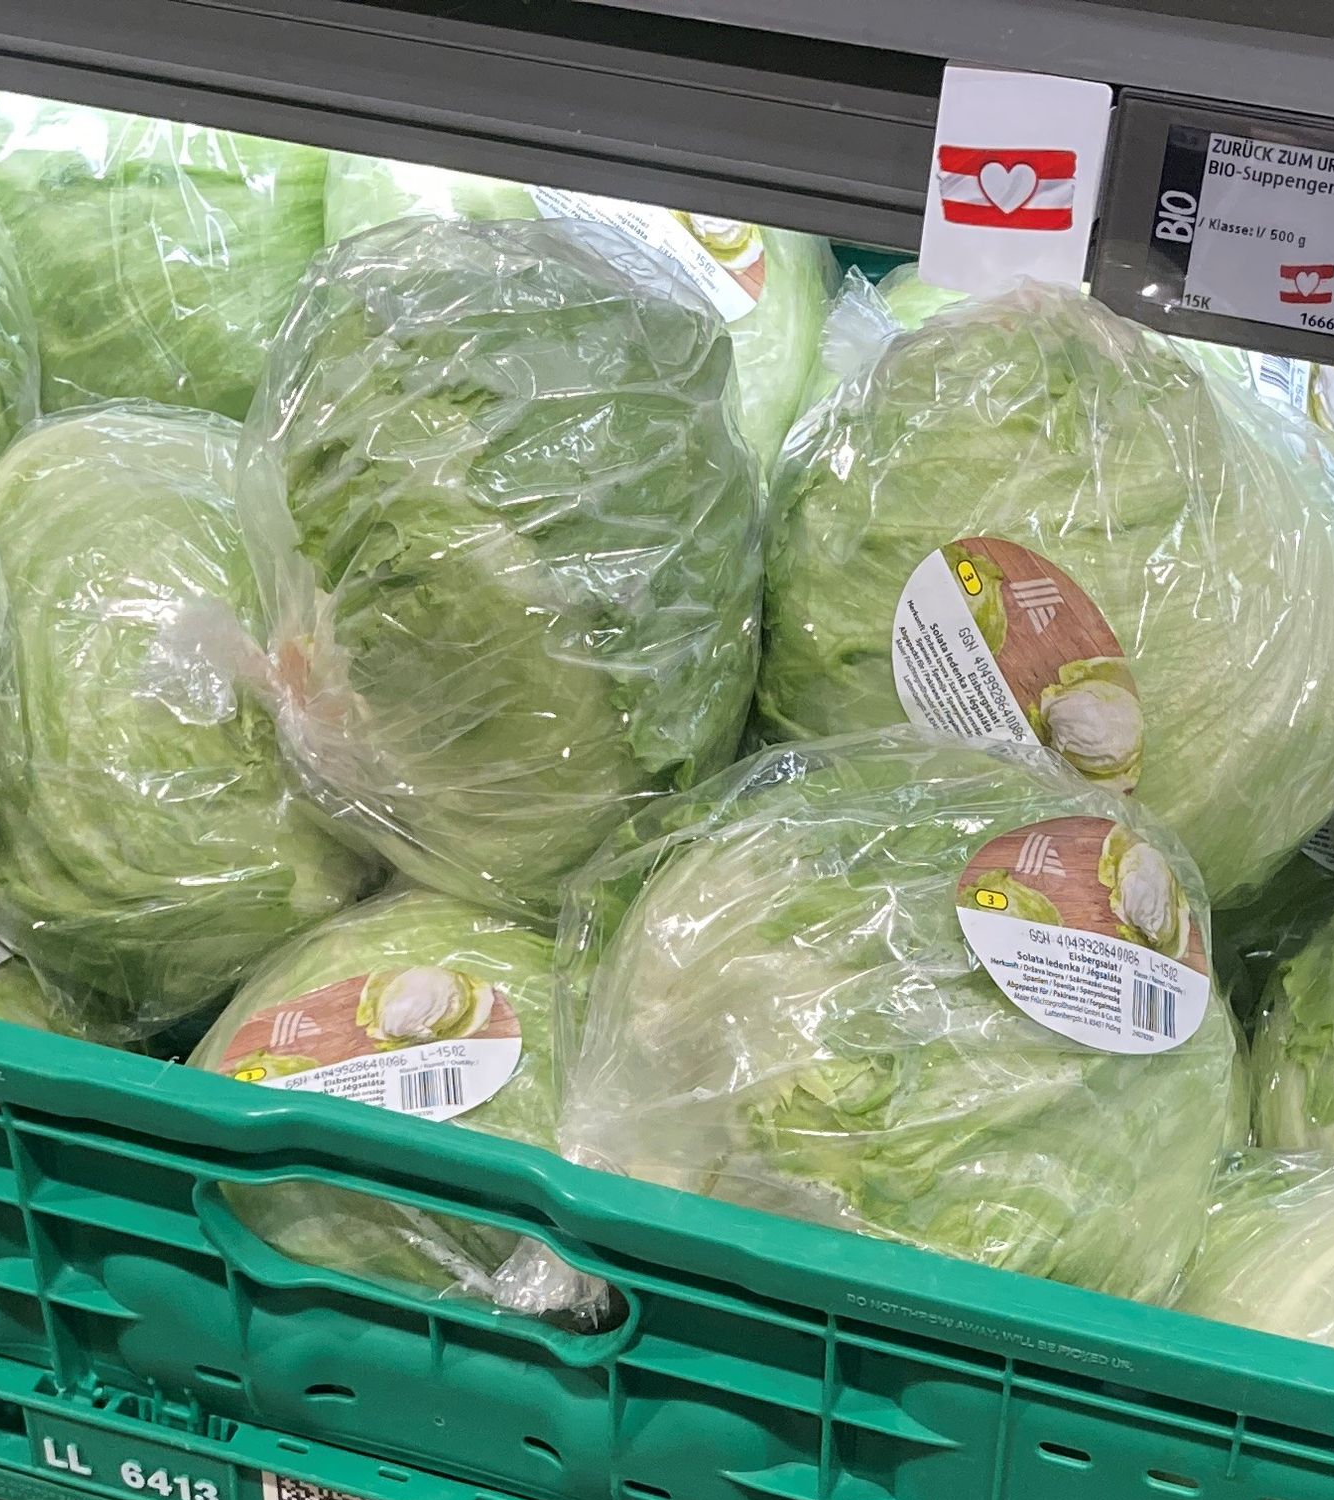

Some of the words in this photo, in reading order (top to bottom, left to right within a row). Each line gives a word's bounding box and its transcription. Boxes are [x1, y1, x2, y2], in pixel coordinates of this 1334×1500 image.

[1211, 136, 1272, 163] ZURÜCK
[1278, 149, 1313, 170] ZUM
[1155, 189, 1198, 245] BIO
[1208, 216, 1255, 239] Klasse:
[1269, 227, 1295, 245] 500
[1297, 233, 1307, 248] g
[1183, 292, 1211, 311] 15K
[963, 572, 974, 582] 3
[928, 622, 950, 653] Solata
[944, 651, 970, 689] ledenka
[964, 692, 993, 734] Jégsaláta
[956, 626, 978, 652] GGN
[971, 654, 1028, 743] 4049928640086
[966, 671, 1001, 725] Eisbergsalat
[987, 894, 995, 906] 3
[1017, 950, 1044, 965] Solata
[1045, 956, 1081, 973] ledenka
[1069, 952, 1118, 972] Eisbergsalat
[420, 1044, 468, 1062] L-1502
[324, 1071, 380, 1088] Eisbergsalat
[42, 1437, 93, 1476] LL
